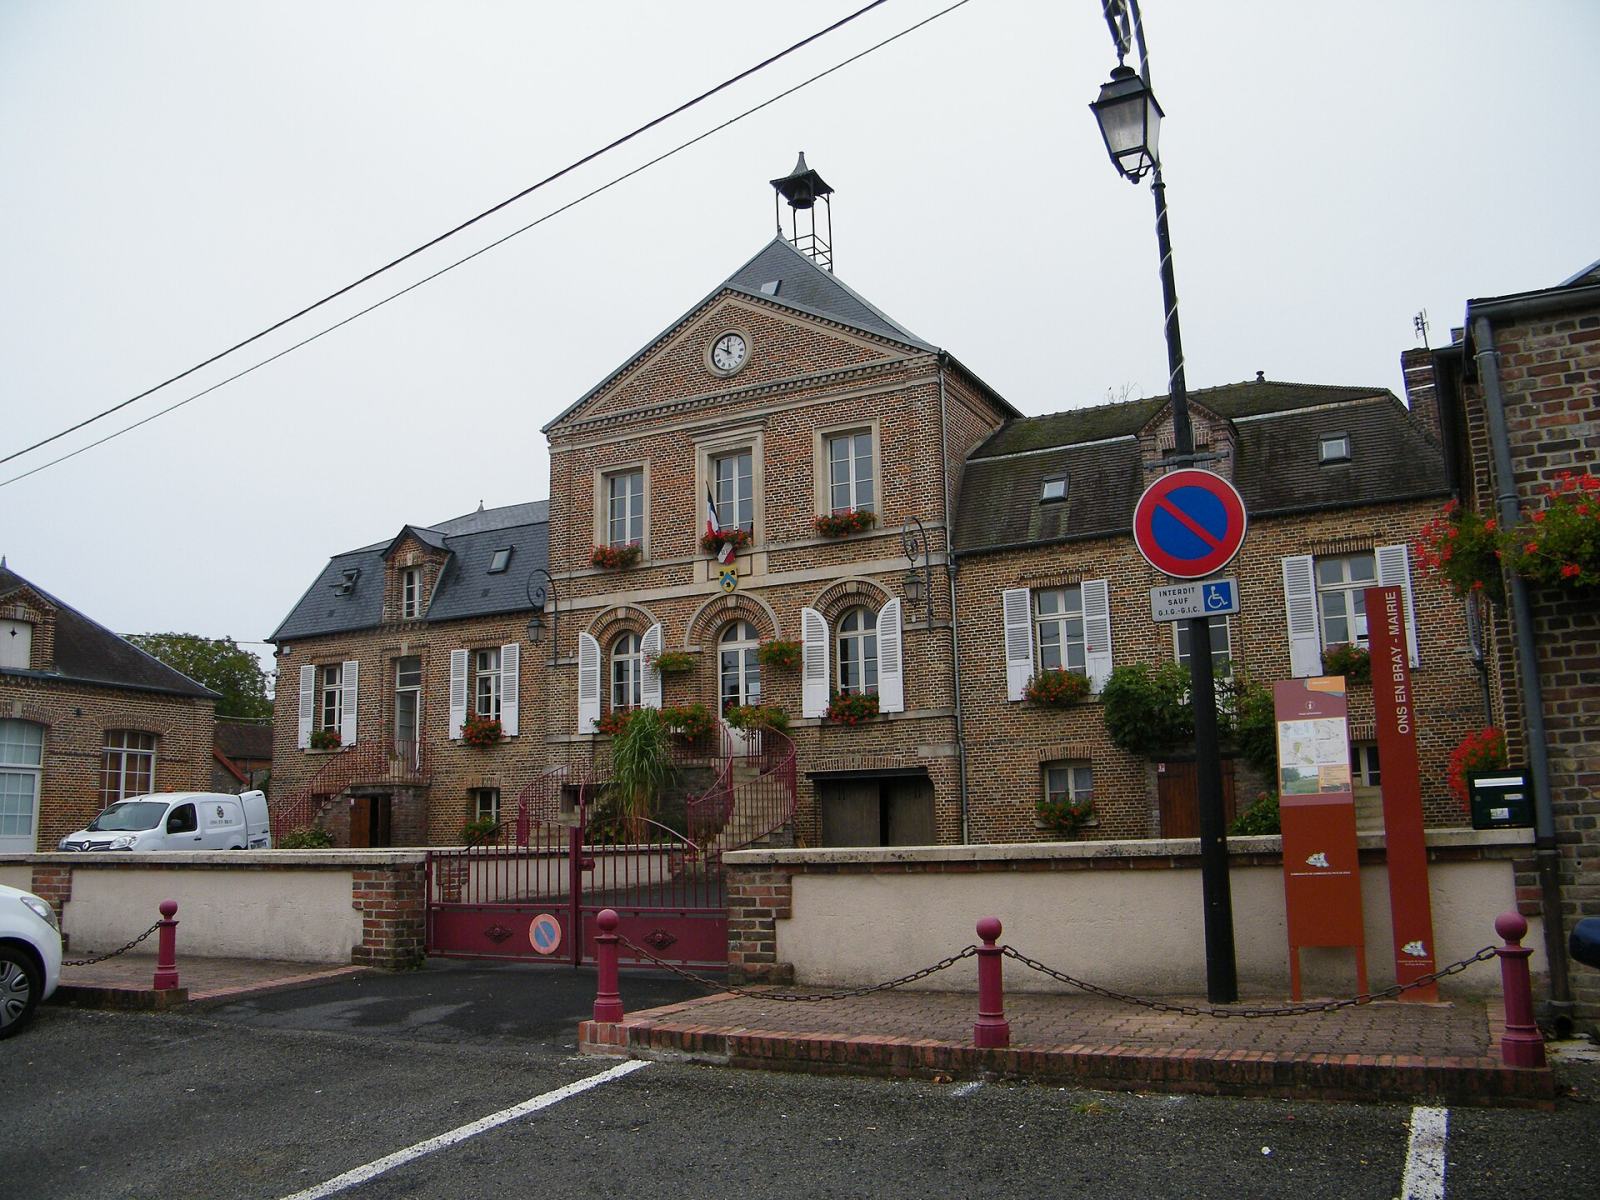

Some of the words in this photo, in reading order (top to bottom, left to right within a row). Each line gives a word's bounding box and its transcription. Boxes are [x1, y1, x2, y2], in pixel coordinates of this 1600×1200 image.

[1159, 587, 1195, 597] INTERDIT
[1385, 592, 1400, 635] MAIRIE
[1391, 646, 1404, 681] BRAY
[1395, 685, 1406, 703] EN
[1396, 707, 1409, 734] ONS
